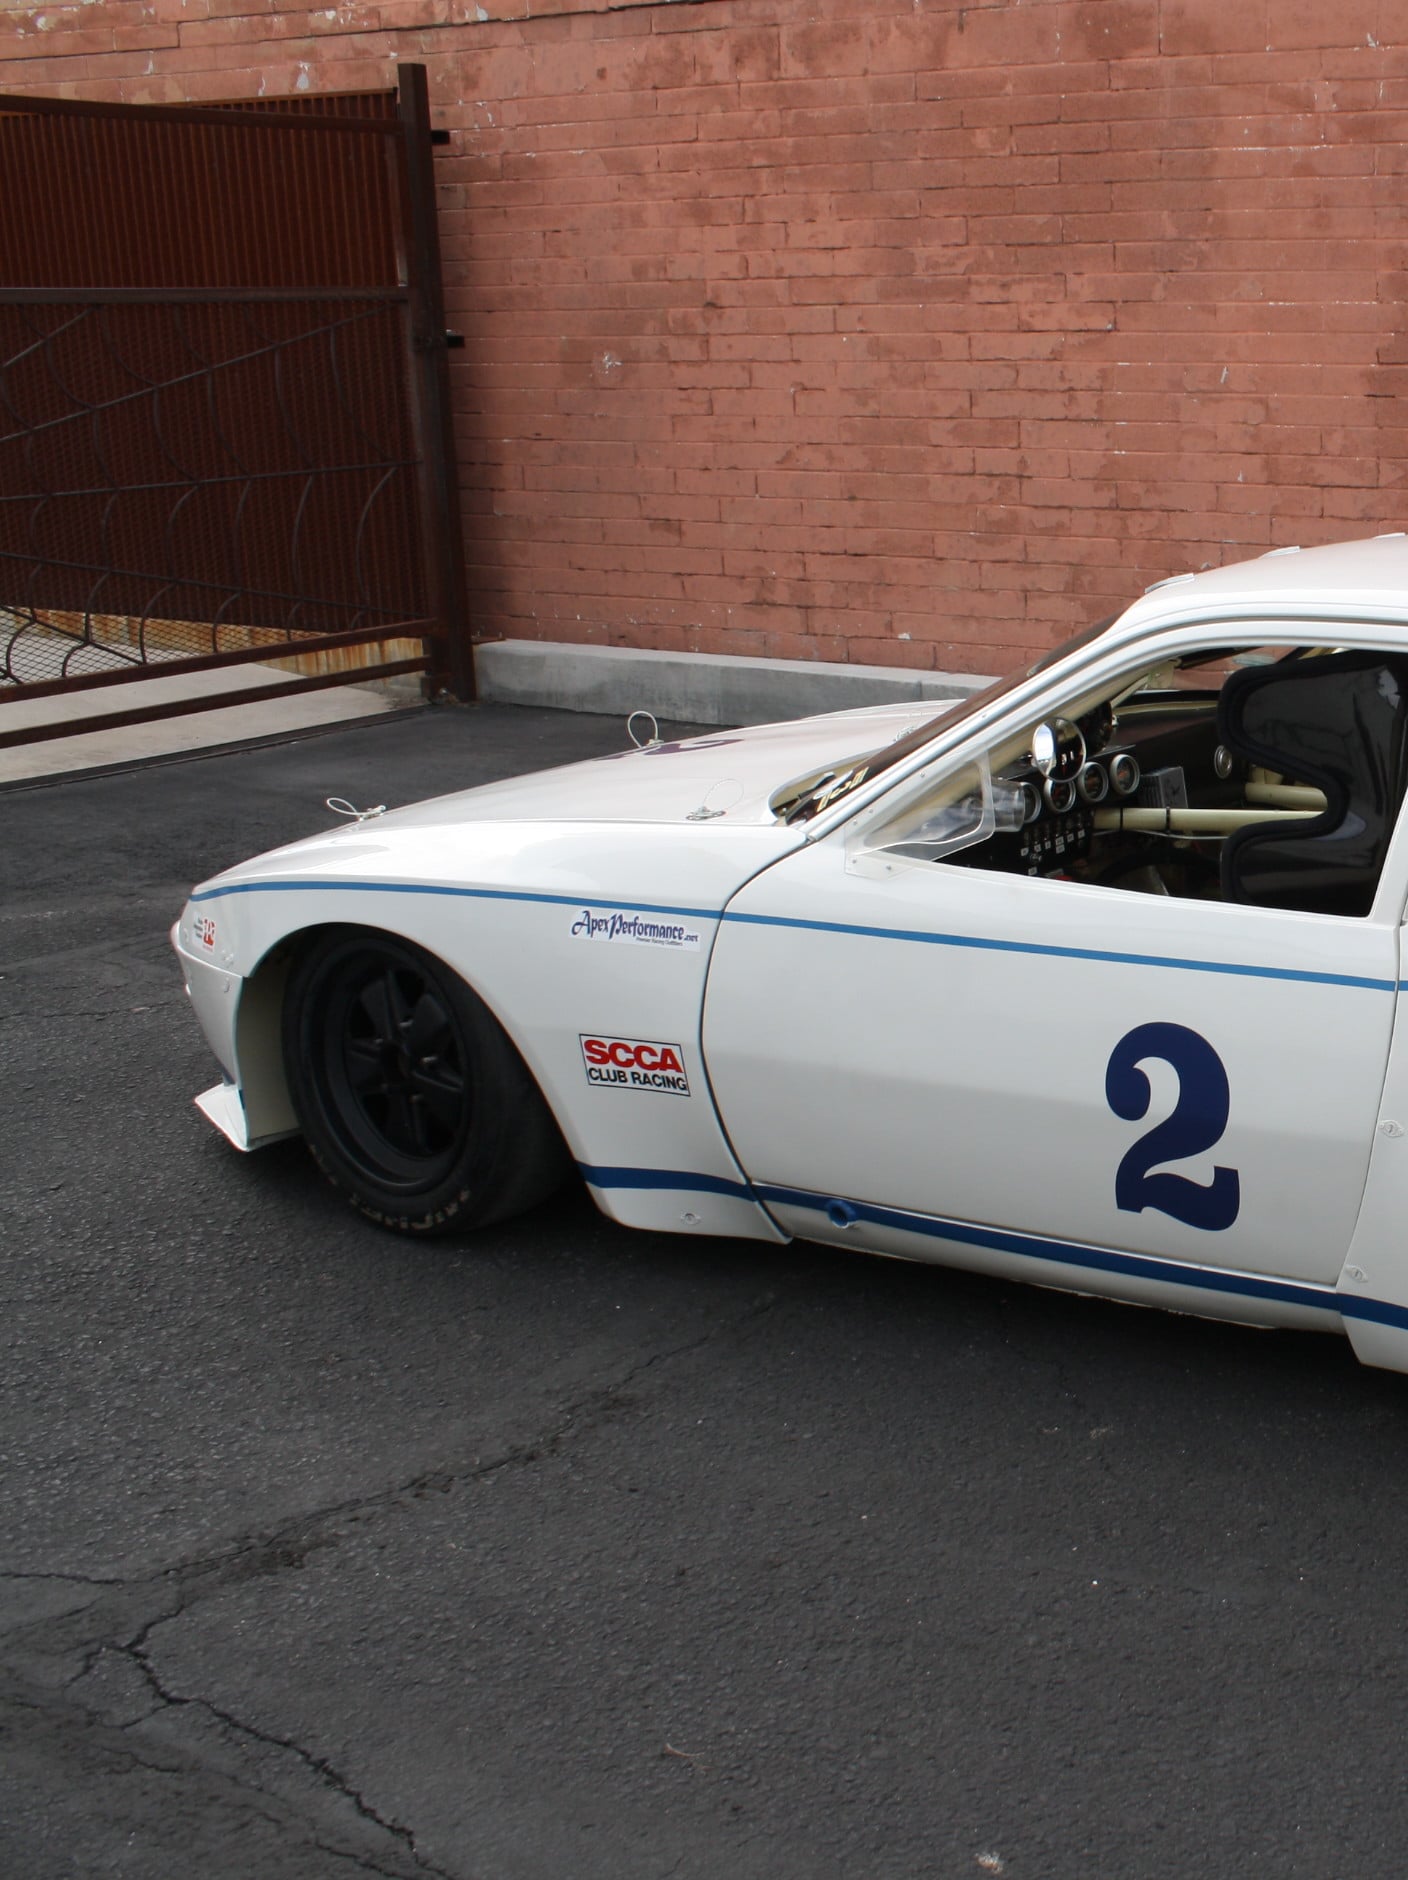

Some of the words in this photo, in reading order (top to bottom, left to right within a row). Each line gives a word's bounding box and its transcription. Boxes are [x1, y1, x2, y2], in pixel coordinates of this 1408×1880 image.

[583, 1039, 684, 1074] SCCA
[588, 1066, 629, 1084] CLUB
[632, 1070, 688, 1092] RACING
[1105, 1021, 1241, 1232] 2
